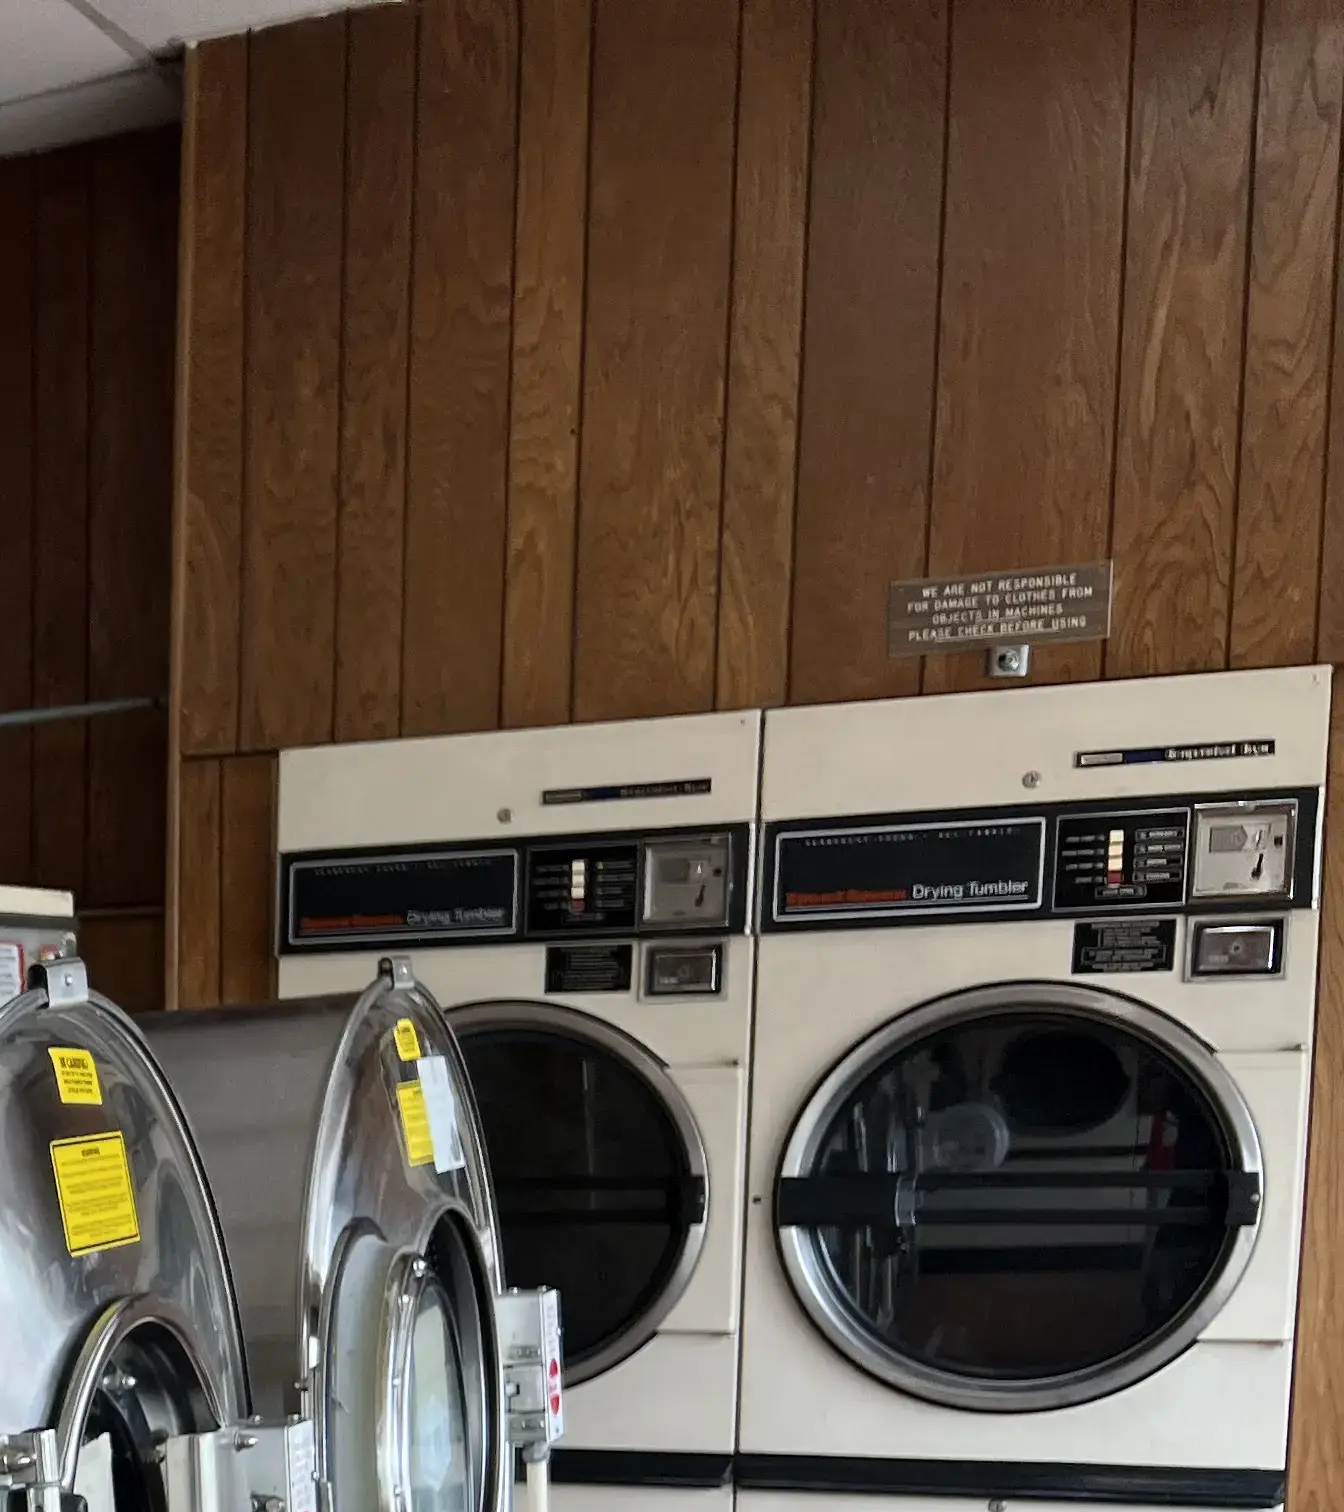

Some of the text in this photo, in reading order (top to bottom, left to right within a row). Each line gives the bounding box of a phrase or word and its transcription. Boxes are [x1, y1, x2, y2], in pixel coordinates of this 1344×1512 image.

[944, 584, 965, 596] ARE
[971, 581, 992, 594] NOT
[998, 573, 1077, 591] RESPONSIBLE
[1062, 586, 1093, 599] FROM
[912, 883, 963, 900] Drying
[968, 879, 1029, 897] Tumbler
